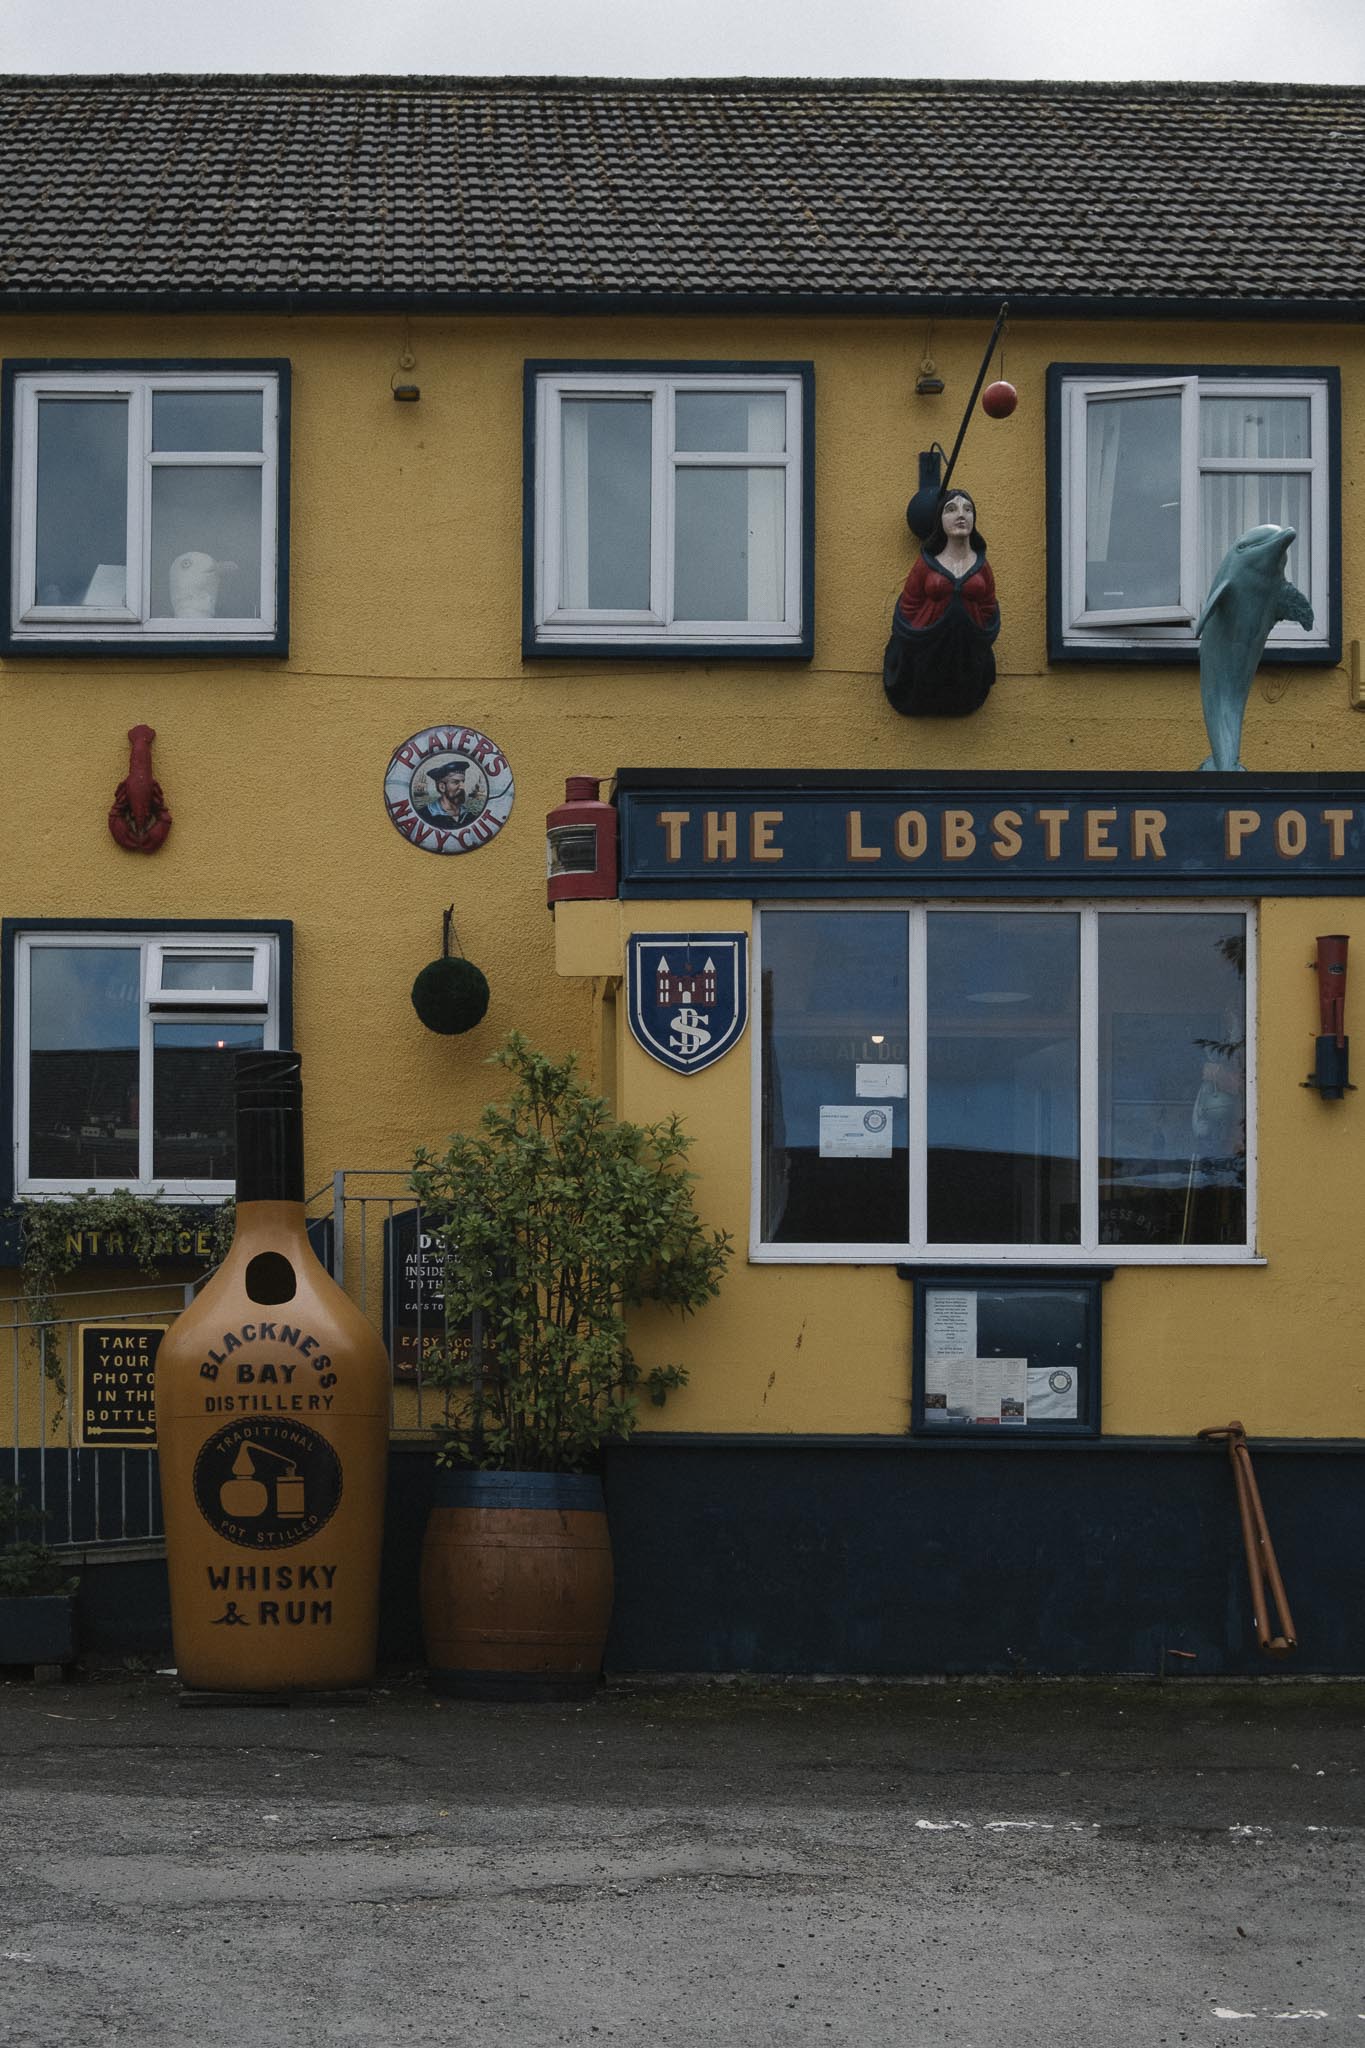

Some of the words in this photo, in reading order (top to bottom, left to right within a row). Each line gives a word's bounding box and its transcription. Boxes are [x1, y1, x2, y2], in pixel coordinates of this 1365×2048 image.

[389, 798, 453, 852] NAVY
[657, 809, 784, 863] THE
[846, 809, 1168, 863] LOBSTER
[1223, 809, 1354, 863] POT
[64, 1231, 212, 1257] NTRNCE
[405, 1266, 446, 1277] INSIDE
[426, 1279, 446, 1290] TH
[405, 1303, 430, 1311] CAS
[431, 1303, 445, 1311] TO
[100, 1336, 148, 1349] TAKE
[401, 1336, 439, 1348] EASY
[99, 1355, 149, 1367] YOUR
[199, 1322, 338, 1389] BLACKNESS
[422, 1350, 469, 1360] RAP
[93, 1372, 155, 1385] PHOTO
[237, 1363, 297, 1385] BAY
[97, 1390, 117, 1402] IN
[205, 1394, 334, 1413] DISTILLERY
[86, 1409, 156, 1421] BOTTLE
[217, 1427, 314, 1453] TRADITIONAL
[220, 1520, 247, 1537] POT
[256, 1514, 319, 1543] STILLED
[207, 1565, 337, 1591] WHISKY
[209, 1601, 251, 1626] &
[258, 1600, 333, 1626] RUM
